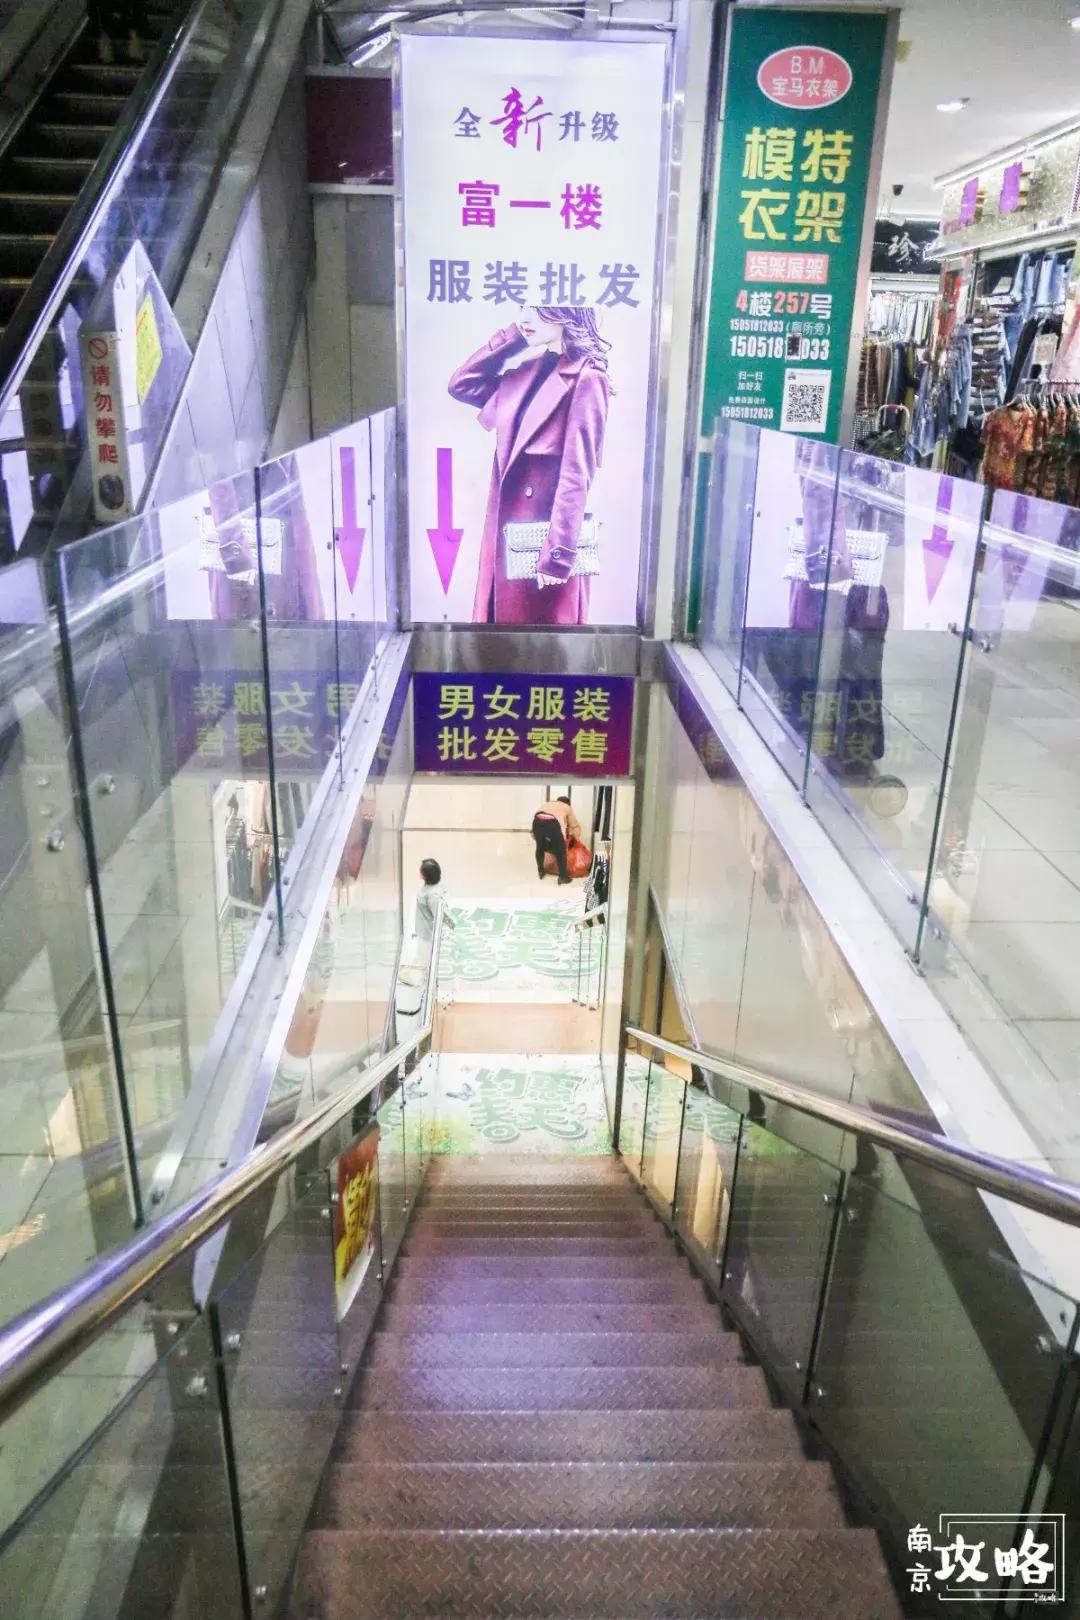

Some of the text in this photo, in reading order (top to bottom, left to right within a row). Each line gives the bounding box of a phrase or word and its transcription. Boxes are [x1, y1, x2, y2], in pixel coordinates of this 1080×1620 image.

[772, 77, 839, 98] 宝马衣架
[453, 86, 620, 152] 全新升级
[742, 126, 854, 185] 模特
[458, 180, 603, 230] 富一楼
[739, 188, 847, 243] 衣架
[427, 259, 640, 308] 服装批发
[735, 289, 833, 319] 4楼257号
[89, 365, 119, 465] 请勿攀爬
[437, 685, 611, 722] 男女服装
[437, 726, 608, 764] 批发零售
